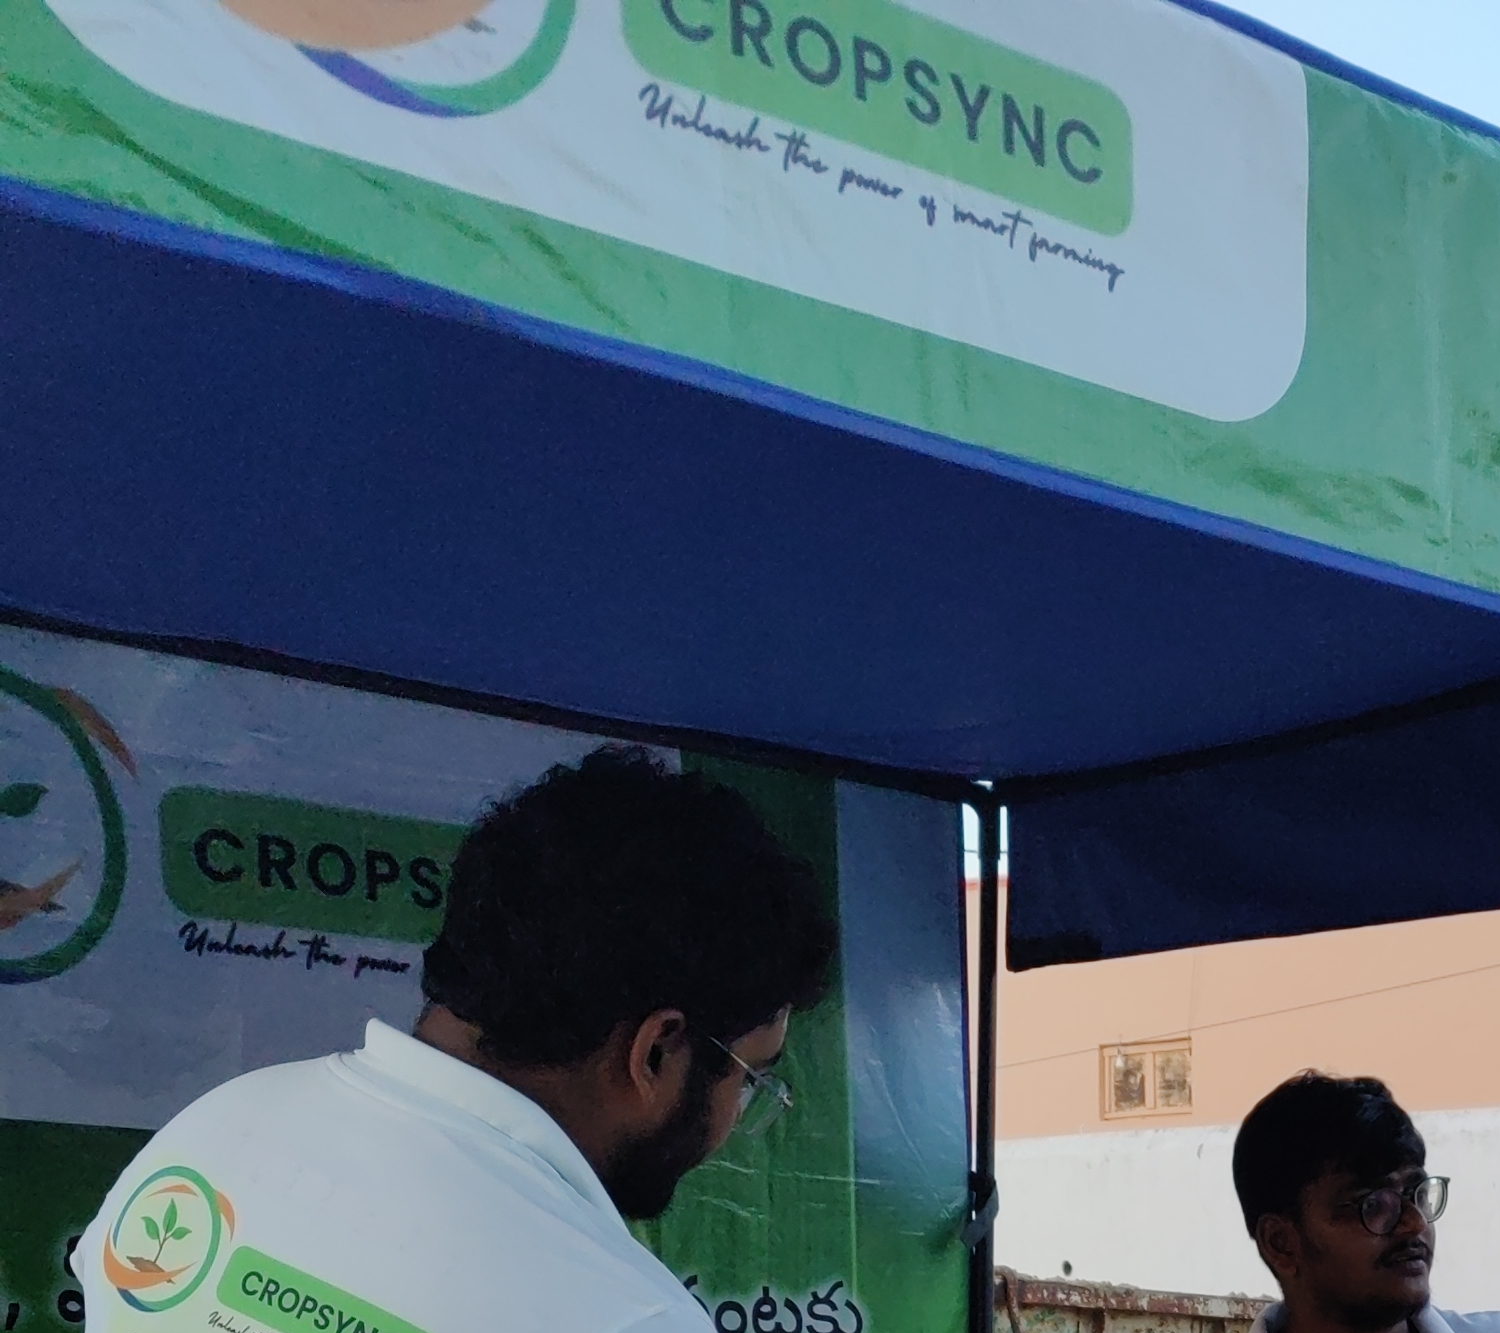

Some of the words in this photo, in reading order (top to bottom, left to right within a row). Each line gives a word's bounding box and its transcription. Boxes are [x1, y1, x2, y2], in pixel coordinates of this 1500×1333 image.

[660, 0, 1104, 184] CROPSYNC
[638, 83, 771, 153] Unleash
[773, 126, 830, 173] the
[837, 166, 903, 194] power
[1028, 230, 1125, 293] farming
[194, 828, 444, 909] CROPS
